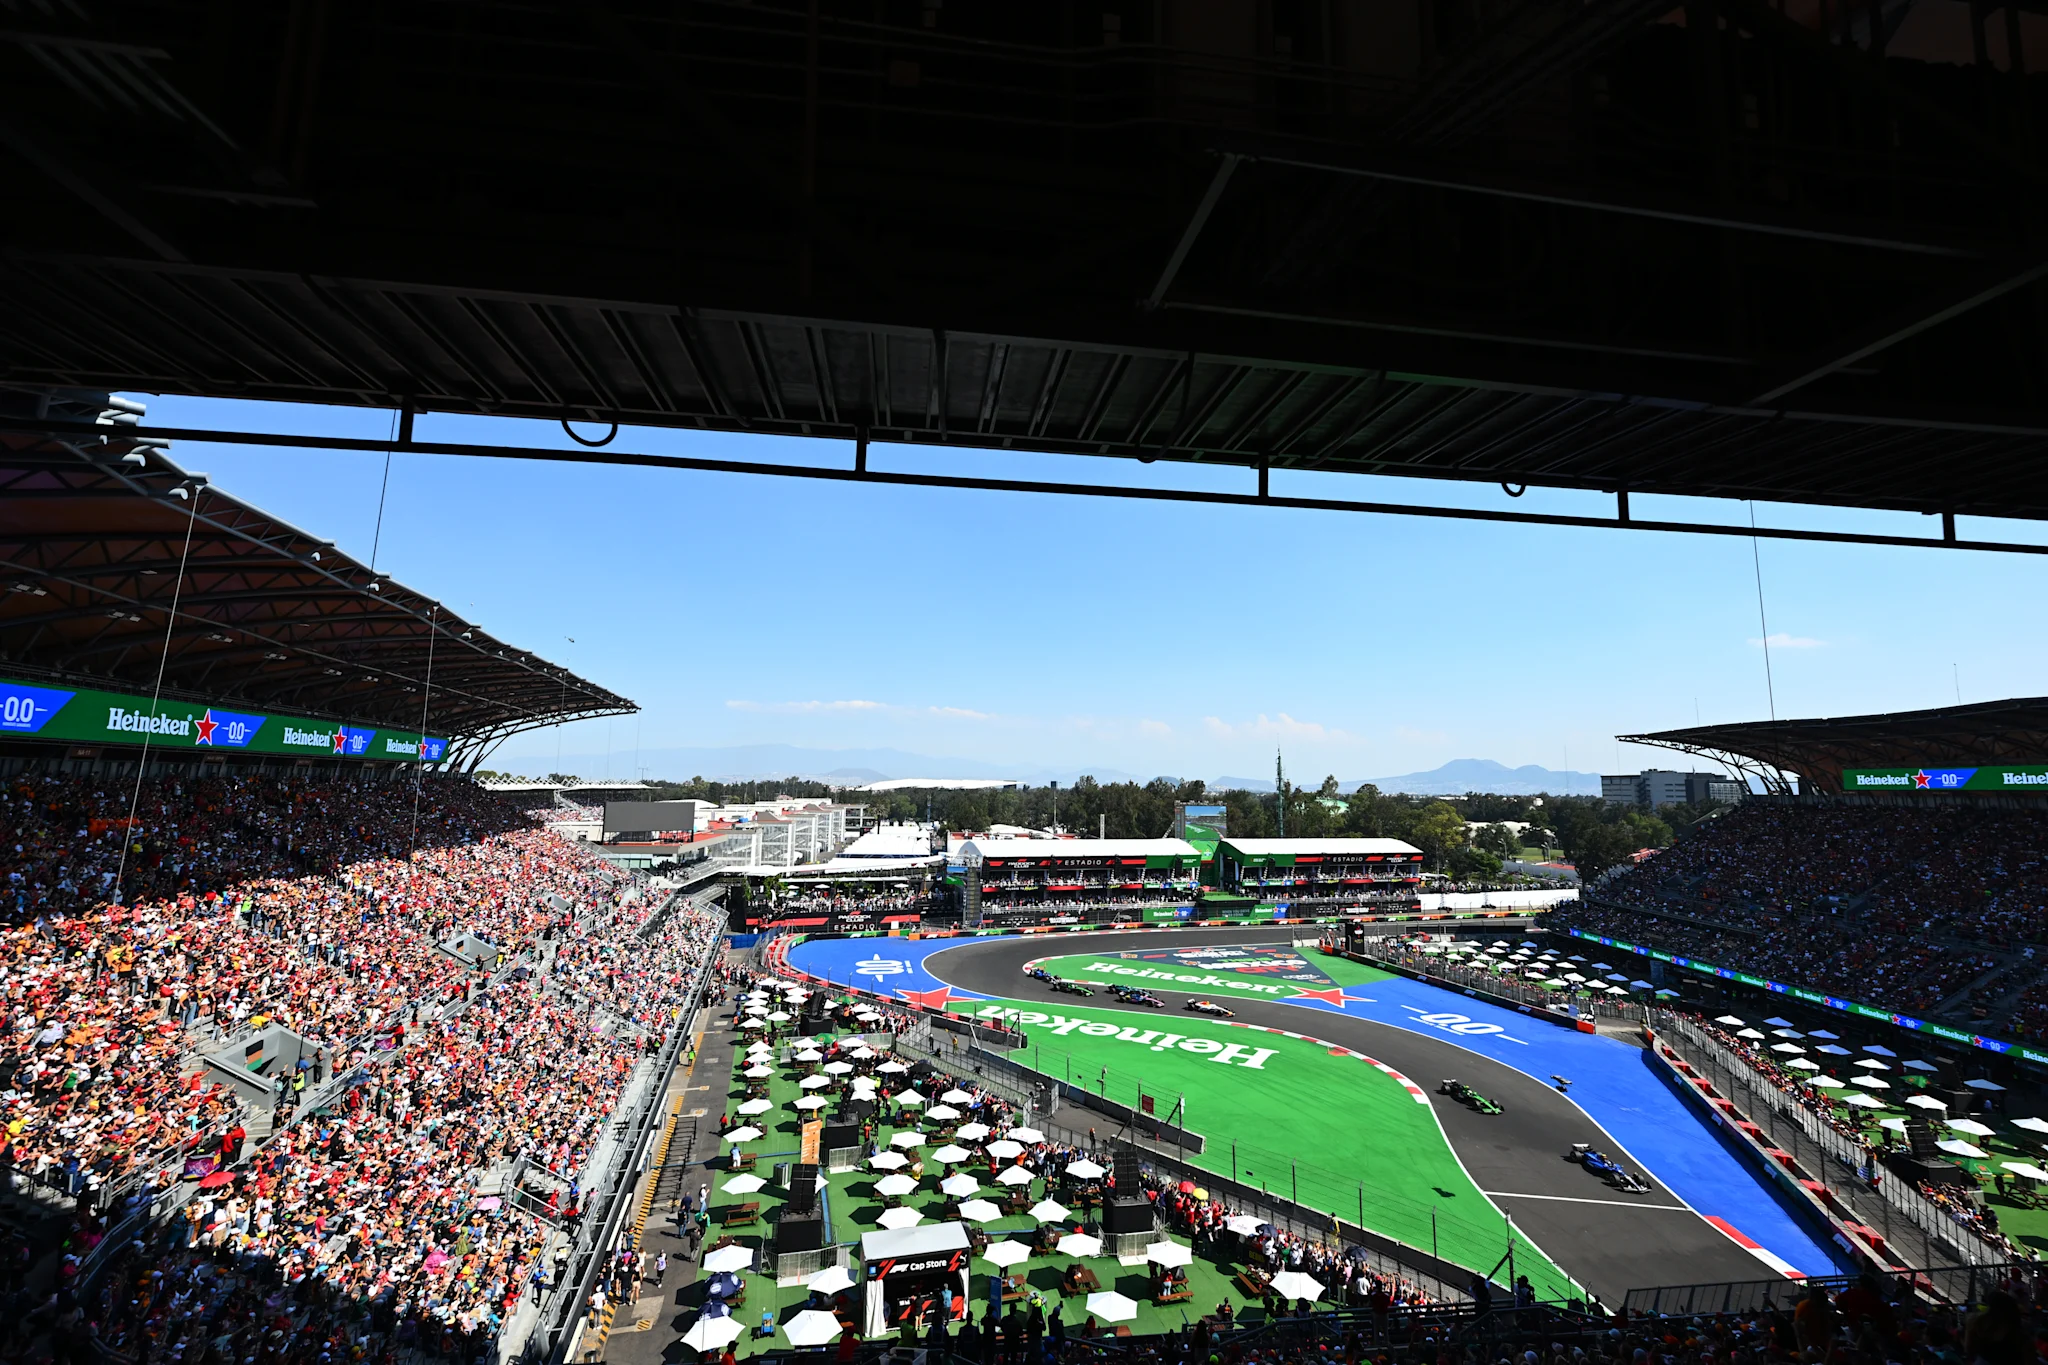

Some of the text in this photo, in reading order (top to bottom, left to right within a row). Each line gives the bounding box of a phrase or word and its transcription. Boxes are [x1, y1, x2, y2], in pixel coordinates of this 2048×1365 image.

[107, 707, 190, 736] Heineken
[283, 727, 330, 747] Heineken
[386, 738, 417, 754] Heineken
[1856, 774, 1909, 785] Heineken
[834, 923, 875, 931] ESTADIO
[1082, 962, 1281, 994] Heineken
[1858, 1006, 1889, 1021] Heineken
[976, 1004, 1280, 1070] Heineken
[1933, 1026, 1970, 1043] Heineken
[910, 1262, 925, 1272] Cap
[926, 1259, 947, 1269] Store
